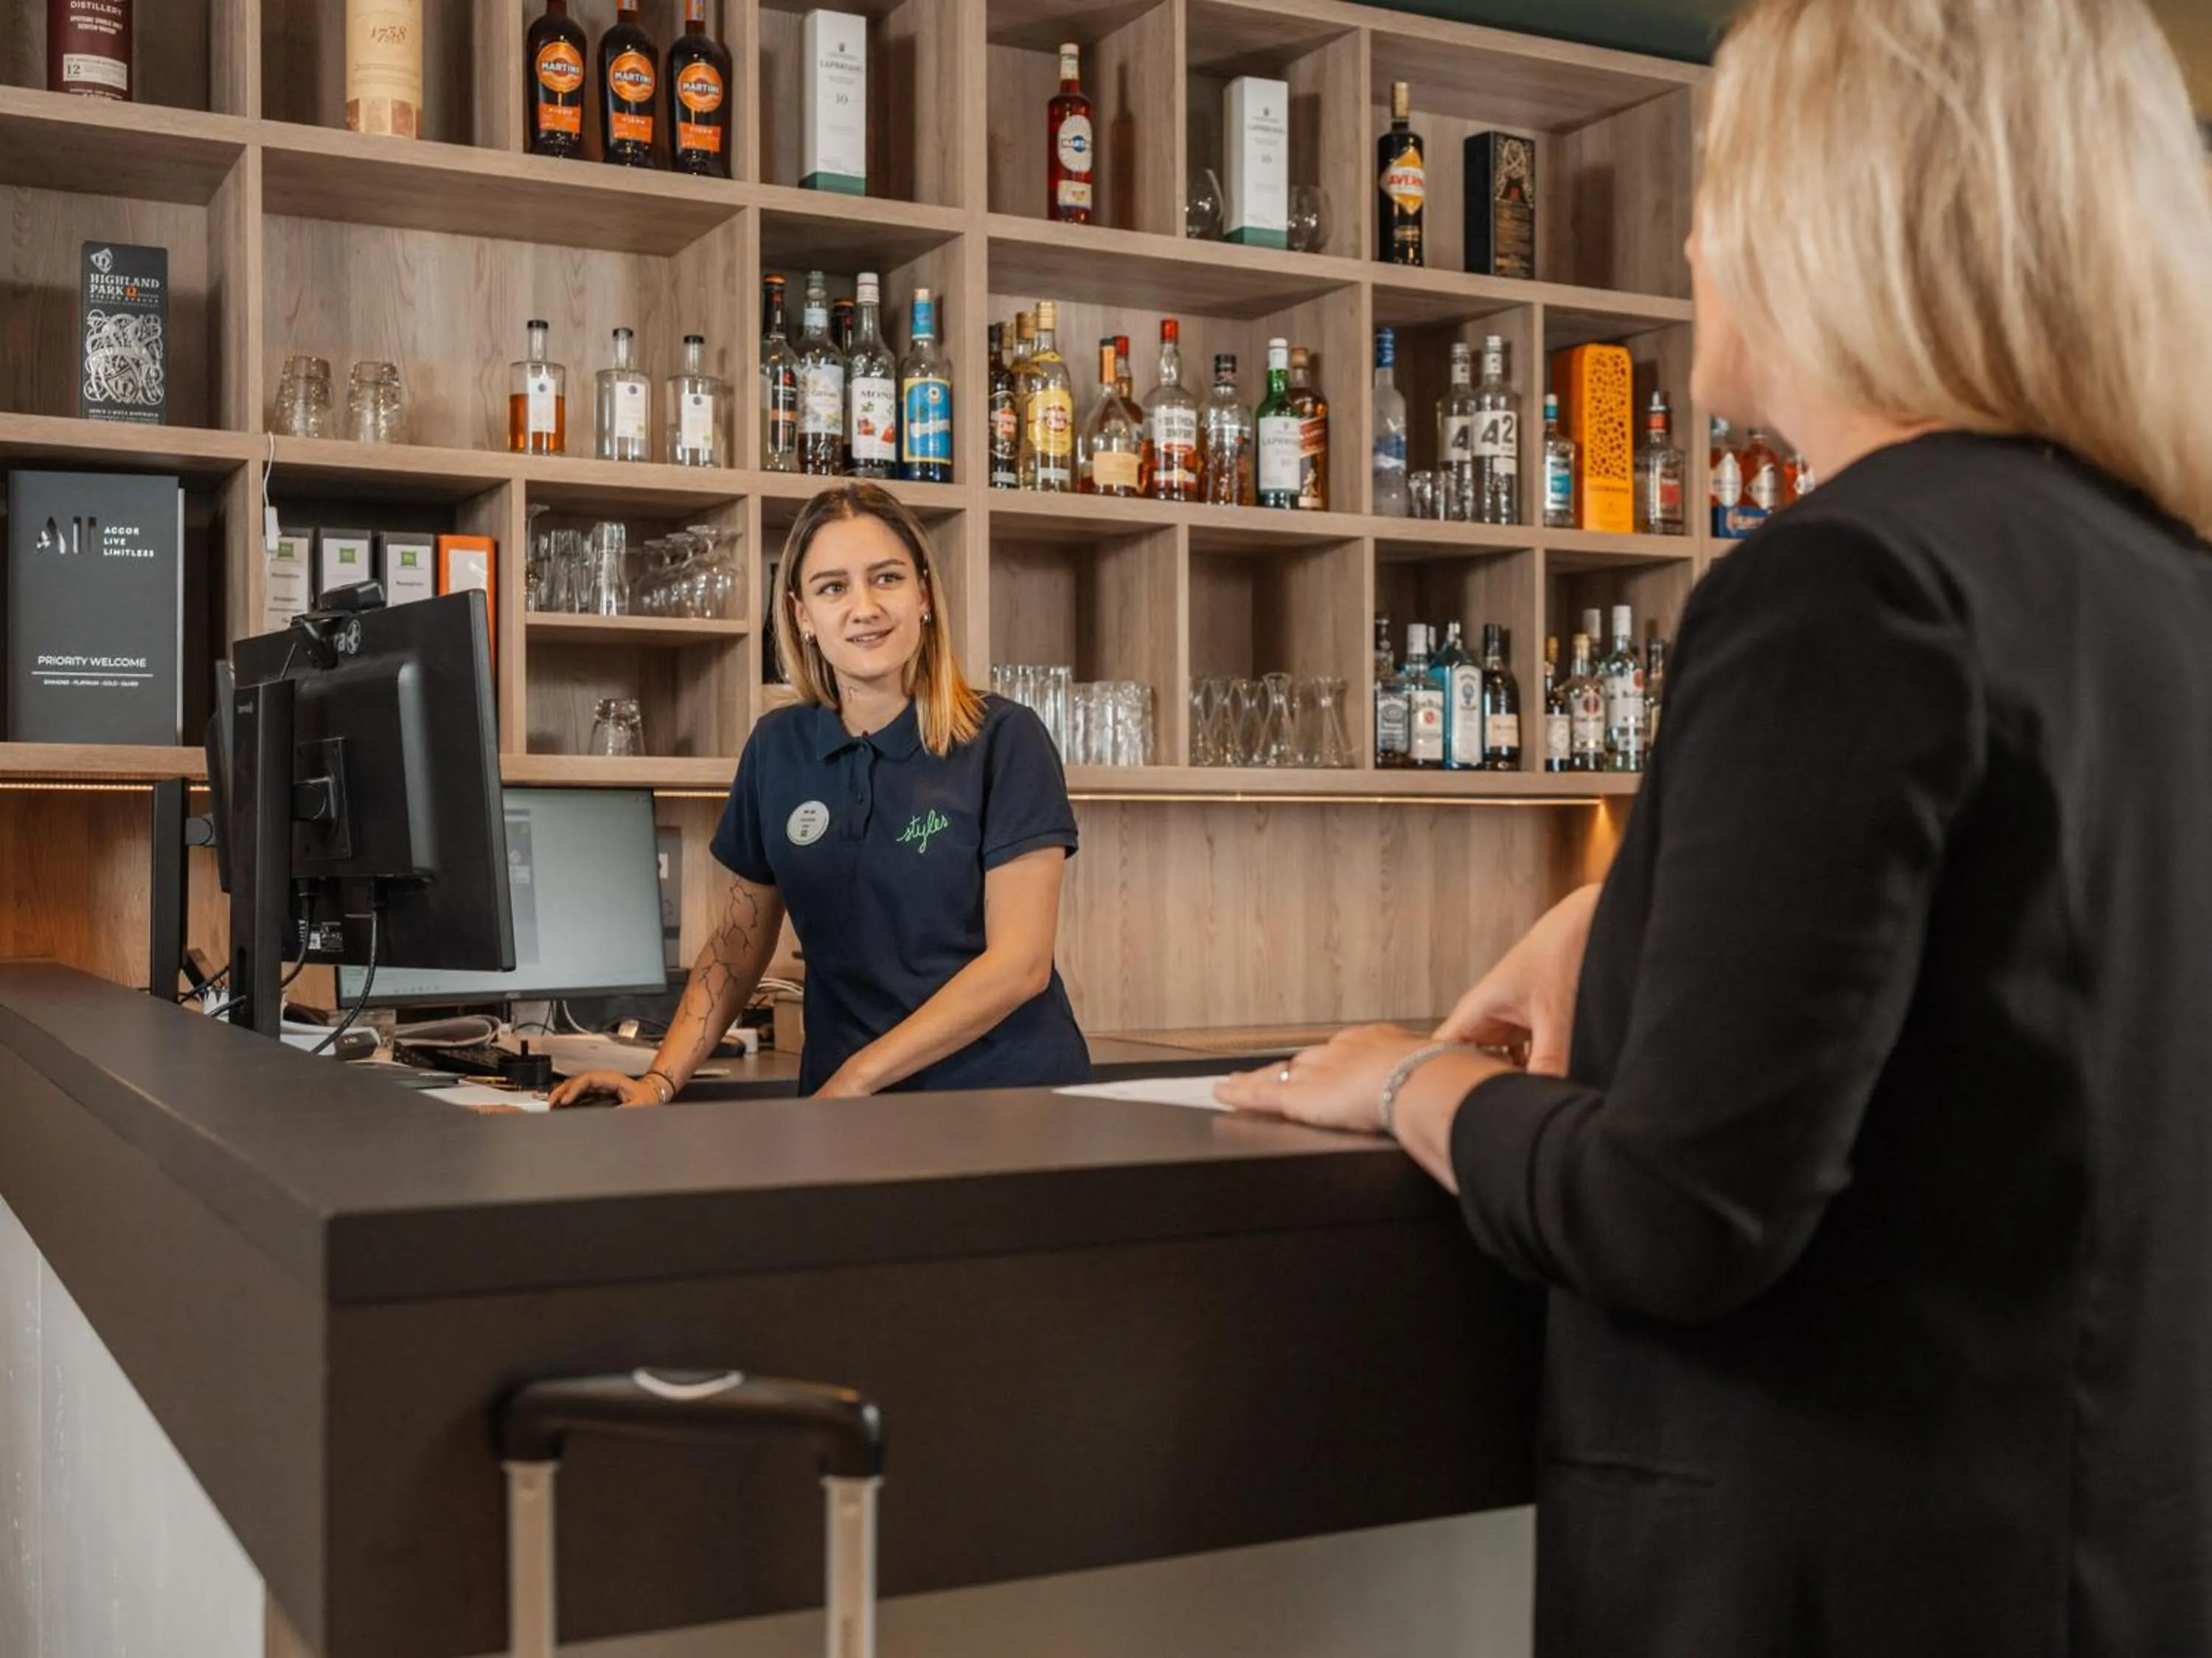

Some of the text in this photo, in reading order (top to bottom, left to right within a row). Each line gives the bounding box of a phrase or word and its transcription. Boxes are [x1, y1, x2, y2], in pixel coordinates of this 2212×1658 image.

[67, 63, 81, 74] 12
[541, 62, 580, 75] MARTINI
[614, 72, 652, 85] MARTINI
[682, 81, 719, 94] MARTINI
[835, 94, 849, 104] 10
[1388, 174, 1425, 186] AVERN
[90, 274, 160, 288] HIGHLAND
[90, 284, 124, 296] PARK
[1481, 415, 1514, 445] 42
[104, 527, 140, 535] ACCOR
[104, 538, 126, 546] LIVE
[104, 548, 155, 558] LIMITLESS
[38, 656, 147, 667] PRIORITY WELCOME
[896, 810, 949, 853] styles
